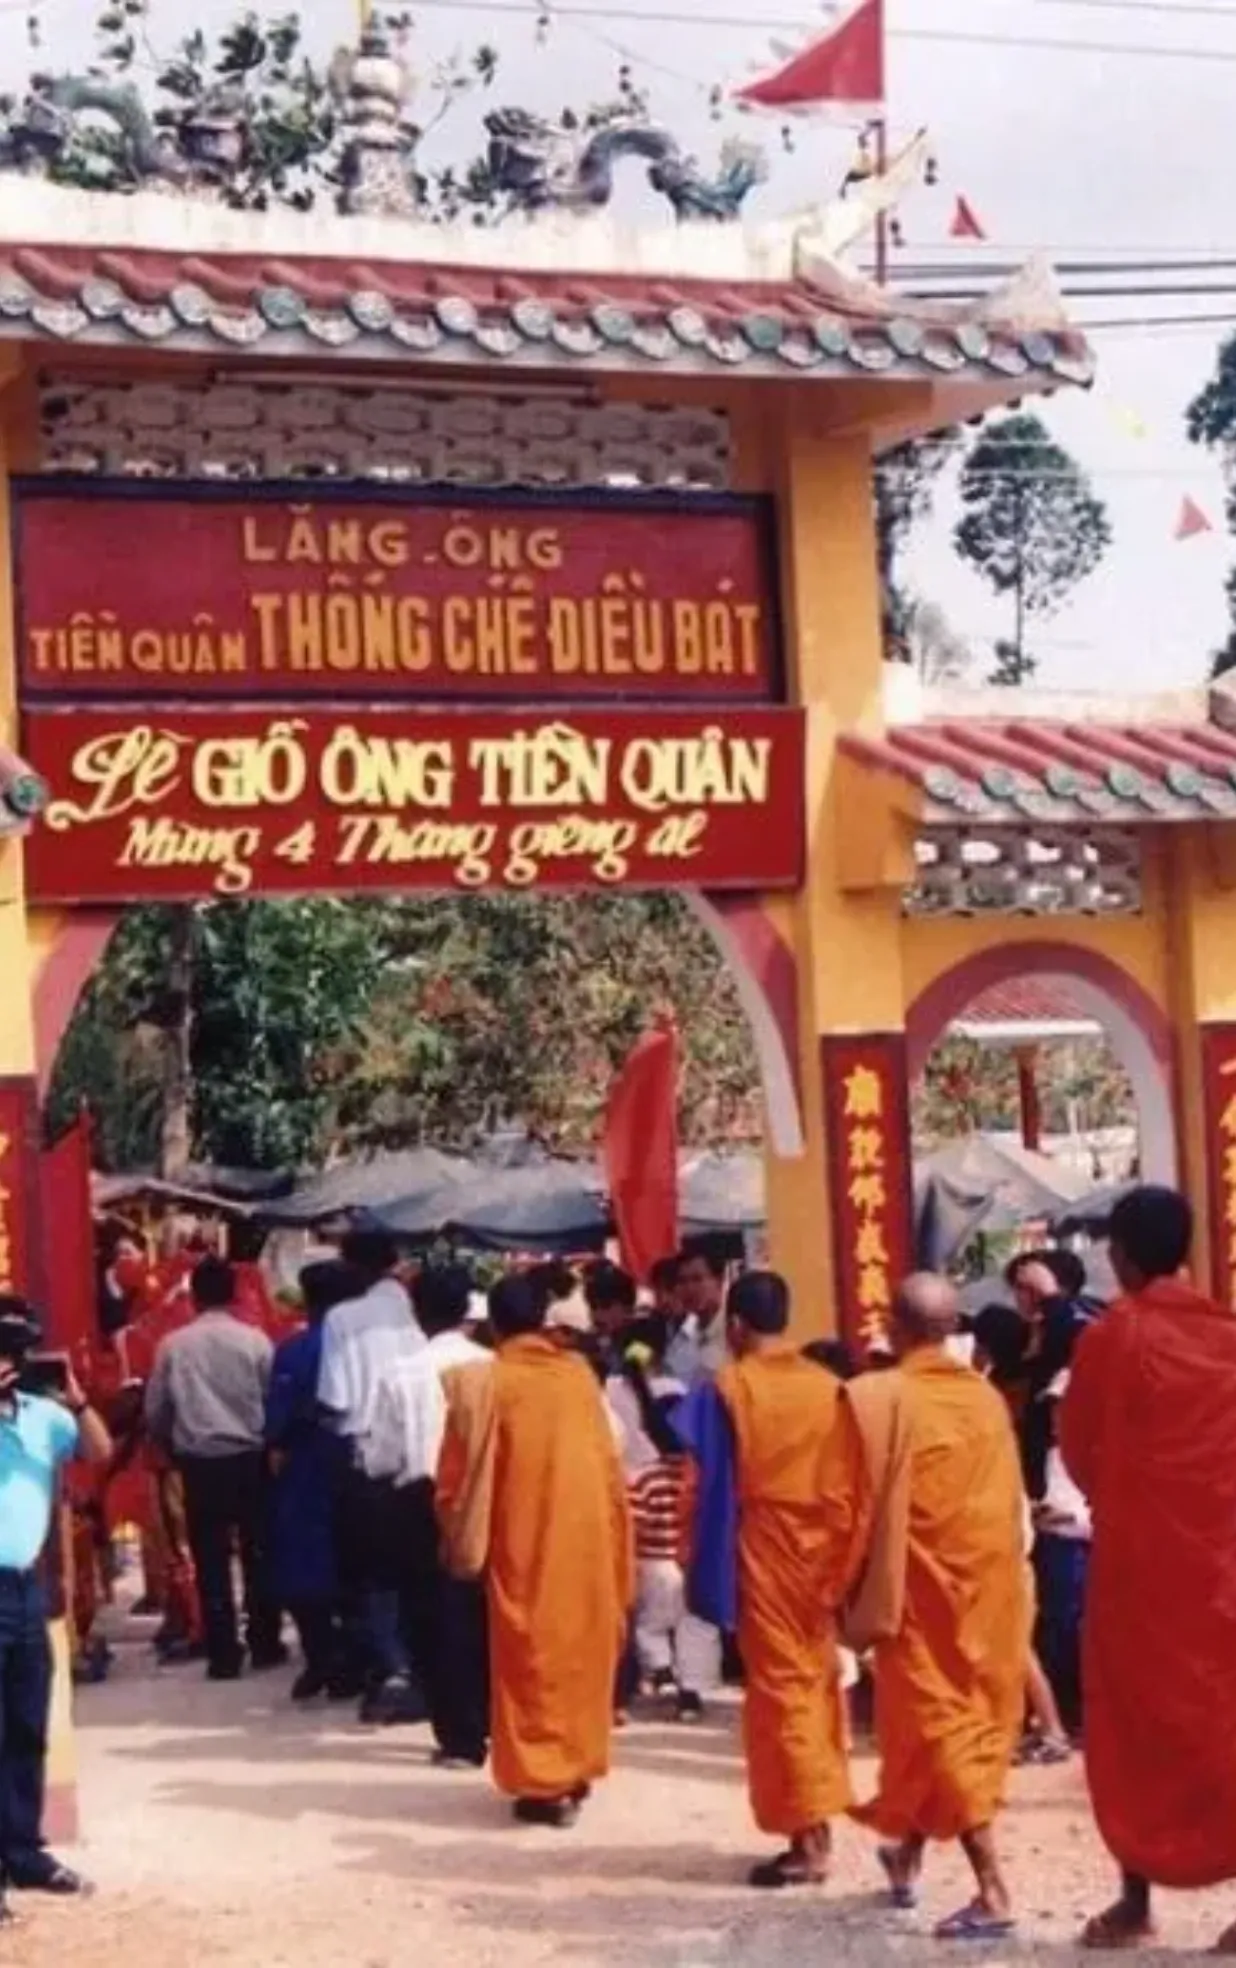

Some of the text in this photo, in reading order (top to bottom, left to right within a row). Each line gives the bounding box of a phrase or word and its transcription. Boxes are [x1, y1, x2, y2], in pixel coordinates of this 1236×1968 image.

[244, 503, 410, 565] LĂNG
[30, 570, 760, 674] TIỀN QUÂN THỐNG CHẾ ĐIỀU BÁT
[319, 724, 455, 807] ÔNG
[468, 721, 612, 806] TIỀN
[620, 726, 772, 812] QUÂN
[274, 821, 316, 862] 4
